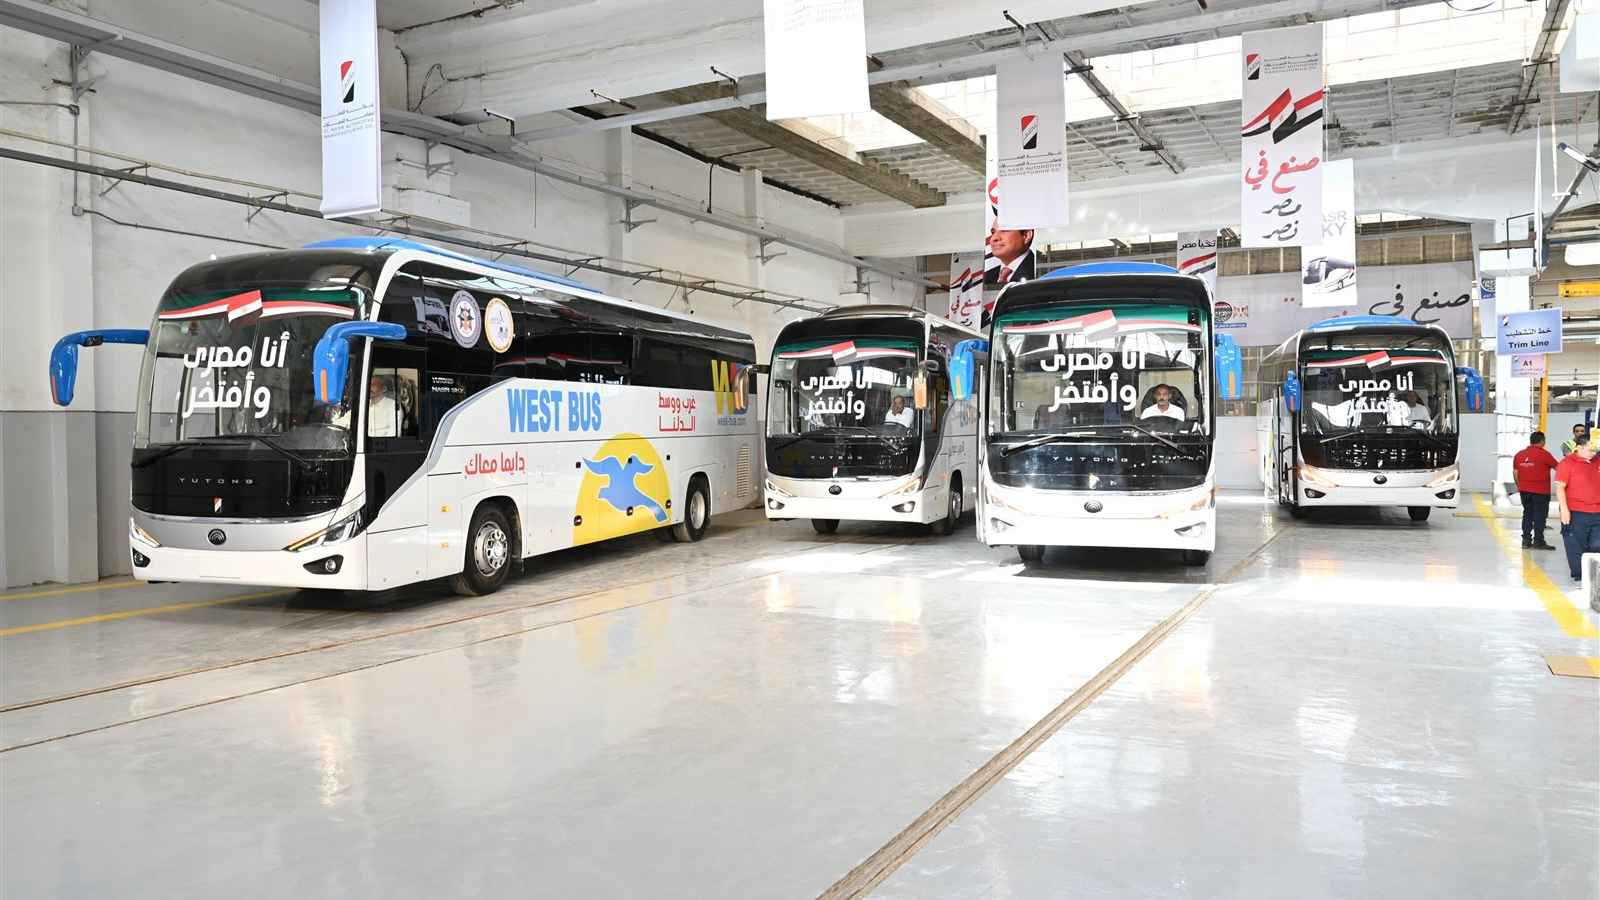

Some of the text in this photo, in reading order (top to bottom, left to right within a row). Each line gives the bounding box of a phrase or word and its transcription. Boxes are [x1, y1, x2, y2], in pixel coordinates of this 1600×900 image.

[1245, 150, 1320, 194] صنع في
[1261, 198, 1302, 217] مصر
[1180, 239, 1216, 251] تحيا مصر
[1261, 220, 1299, 241] نصر
[1321, 222, 1347, 239] KY
[1411, 291, 1470, 325] صنع
[261, 331, 290, 368] أنا
[182, 371, 271, 418] وأفتخر
[1048, 372, 1137, 412] وأفتخر
[1396, 371, 1413, 391] أنا
[507, 388, 602, 433] WEST BUS
[804, 391, 865, 420] وأفتخر
